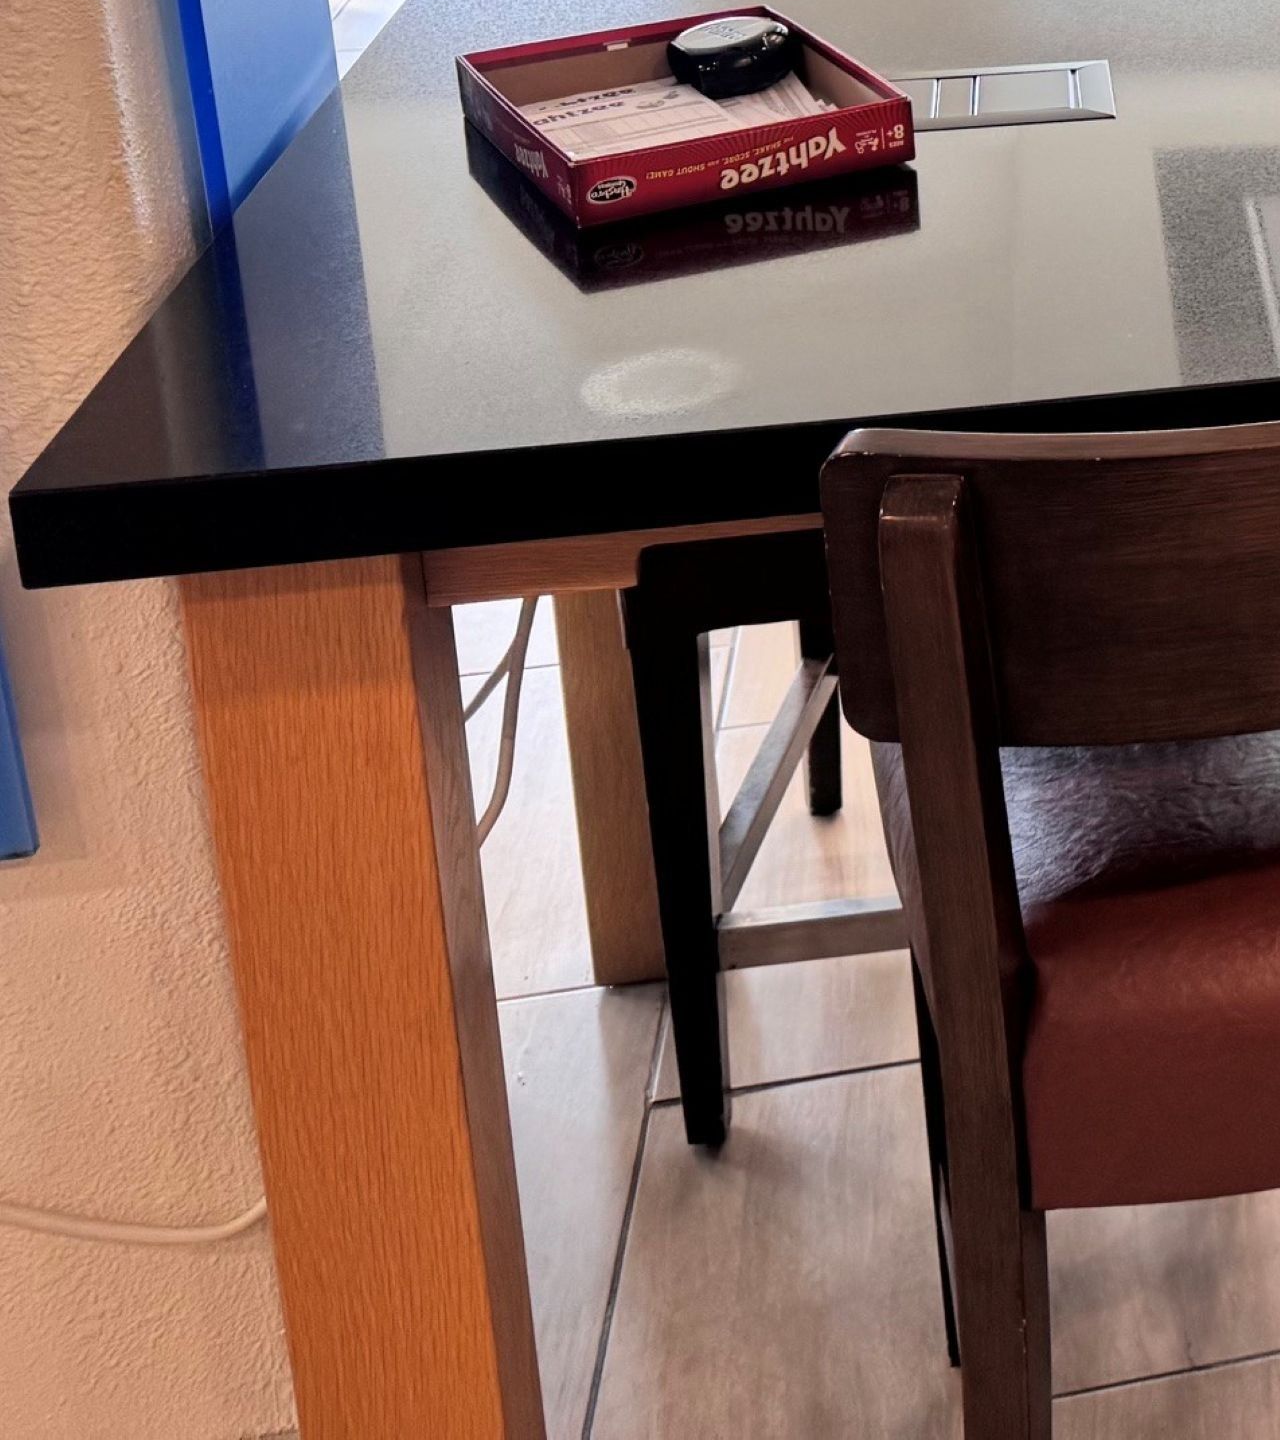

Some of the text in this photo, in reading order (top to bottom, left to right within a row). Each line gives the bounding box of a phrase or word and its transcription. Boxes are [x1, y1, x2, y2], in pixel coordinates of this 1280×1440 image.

[533, 100, 624, 126] ahtzee
[885, 124, 905, 139] 8+
[719, 126, 847, 191] Yahtzee
[675, 163, 706, 175] SHOUT
[588, 183, 634, 201] Hasbro
